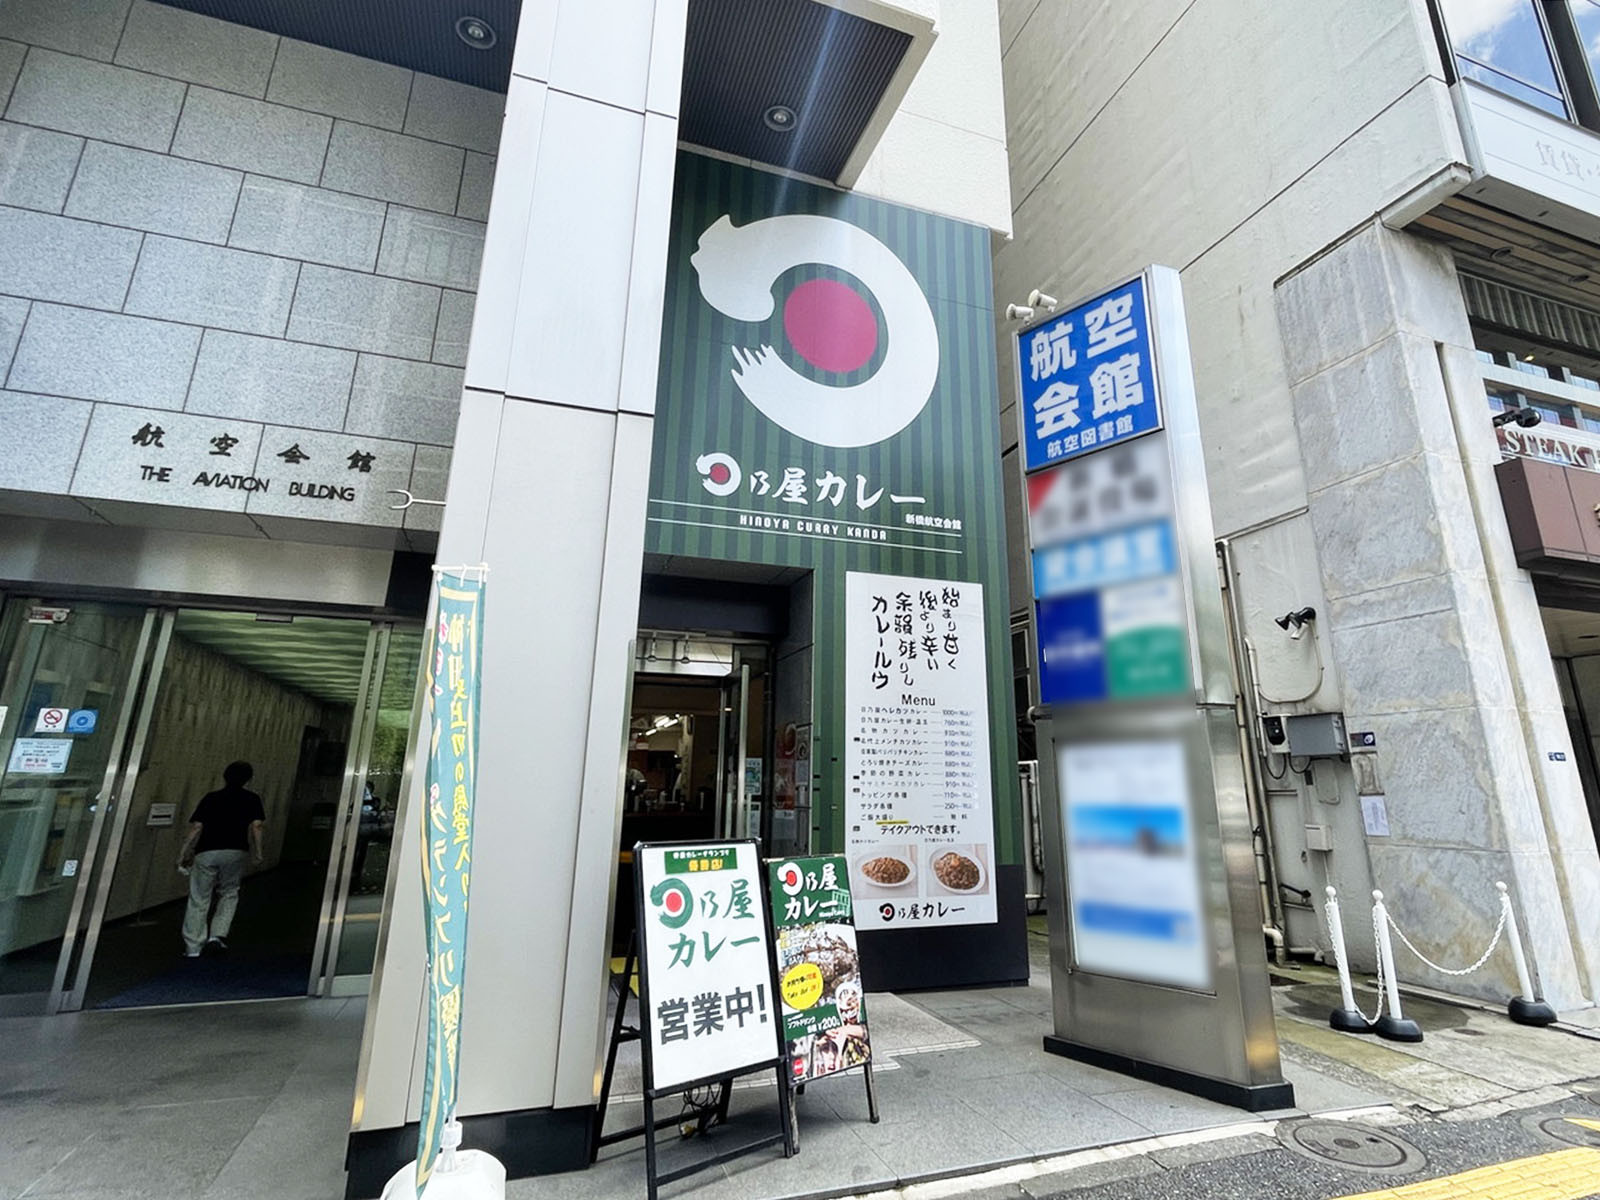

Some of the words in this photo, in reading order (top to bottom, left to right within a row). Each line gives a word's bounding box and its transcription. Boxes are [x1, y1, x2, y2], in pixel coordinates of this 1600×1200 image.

[1029, 292, 1138, 382] 航空
[1032, 352, 1145, 440] 会館
[140, 465, 172, 483] THE
[192, 471, 270, 493] AVIATION
[739, 514, 790, 530] HINOYA
[796, 520, 839, 535] CURRY
[847, 527, 887, 541] KANDA
[872, 595, 892, 689] カレールウ
[901, 694, 936, 706] Menu
[880, 824, 960, 835] テイクアウトできます。
[784, 896, 839, 921] カレー
[668, 931, 760, 970] カレー
[657, 983, 769, 1045] 営業中!
